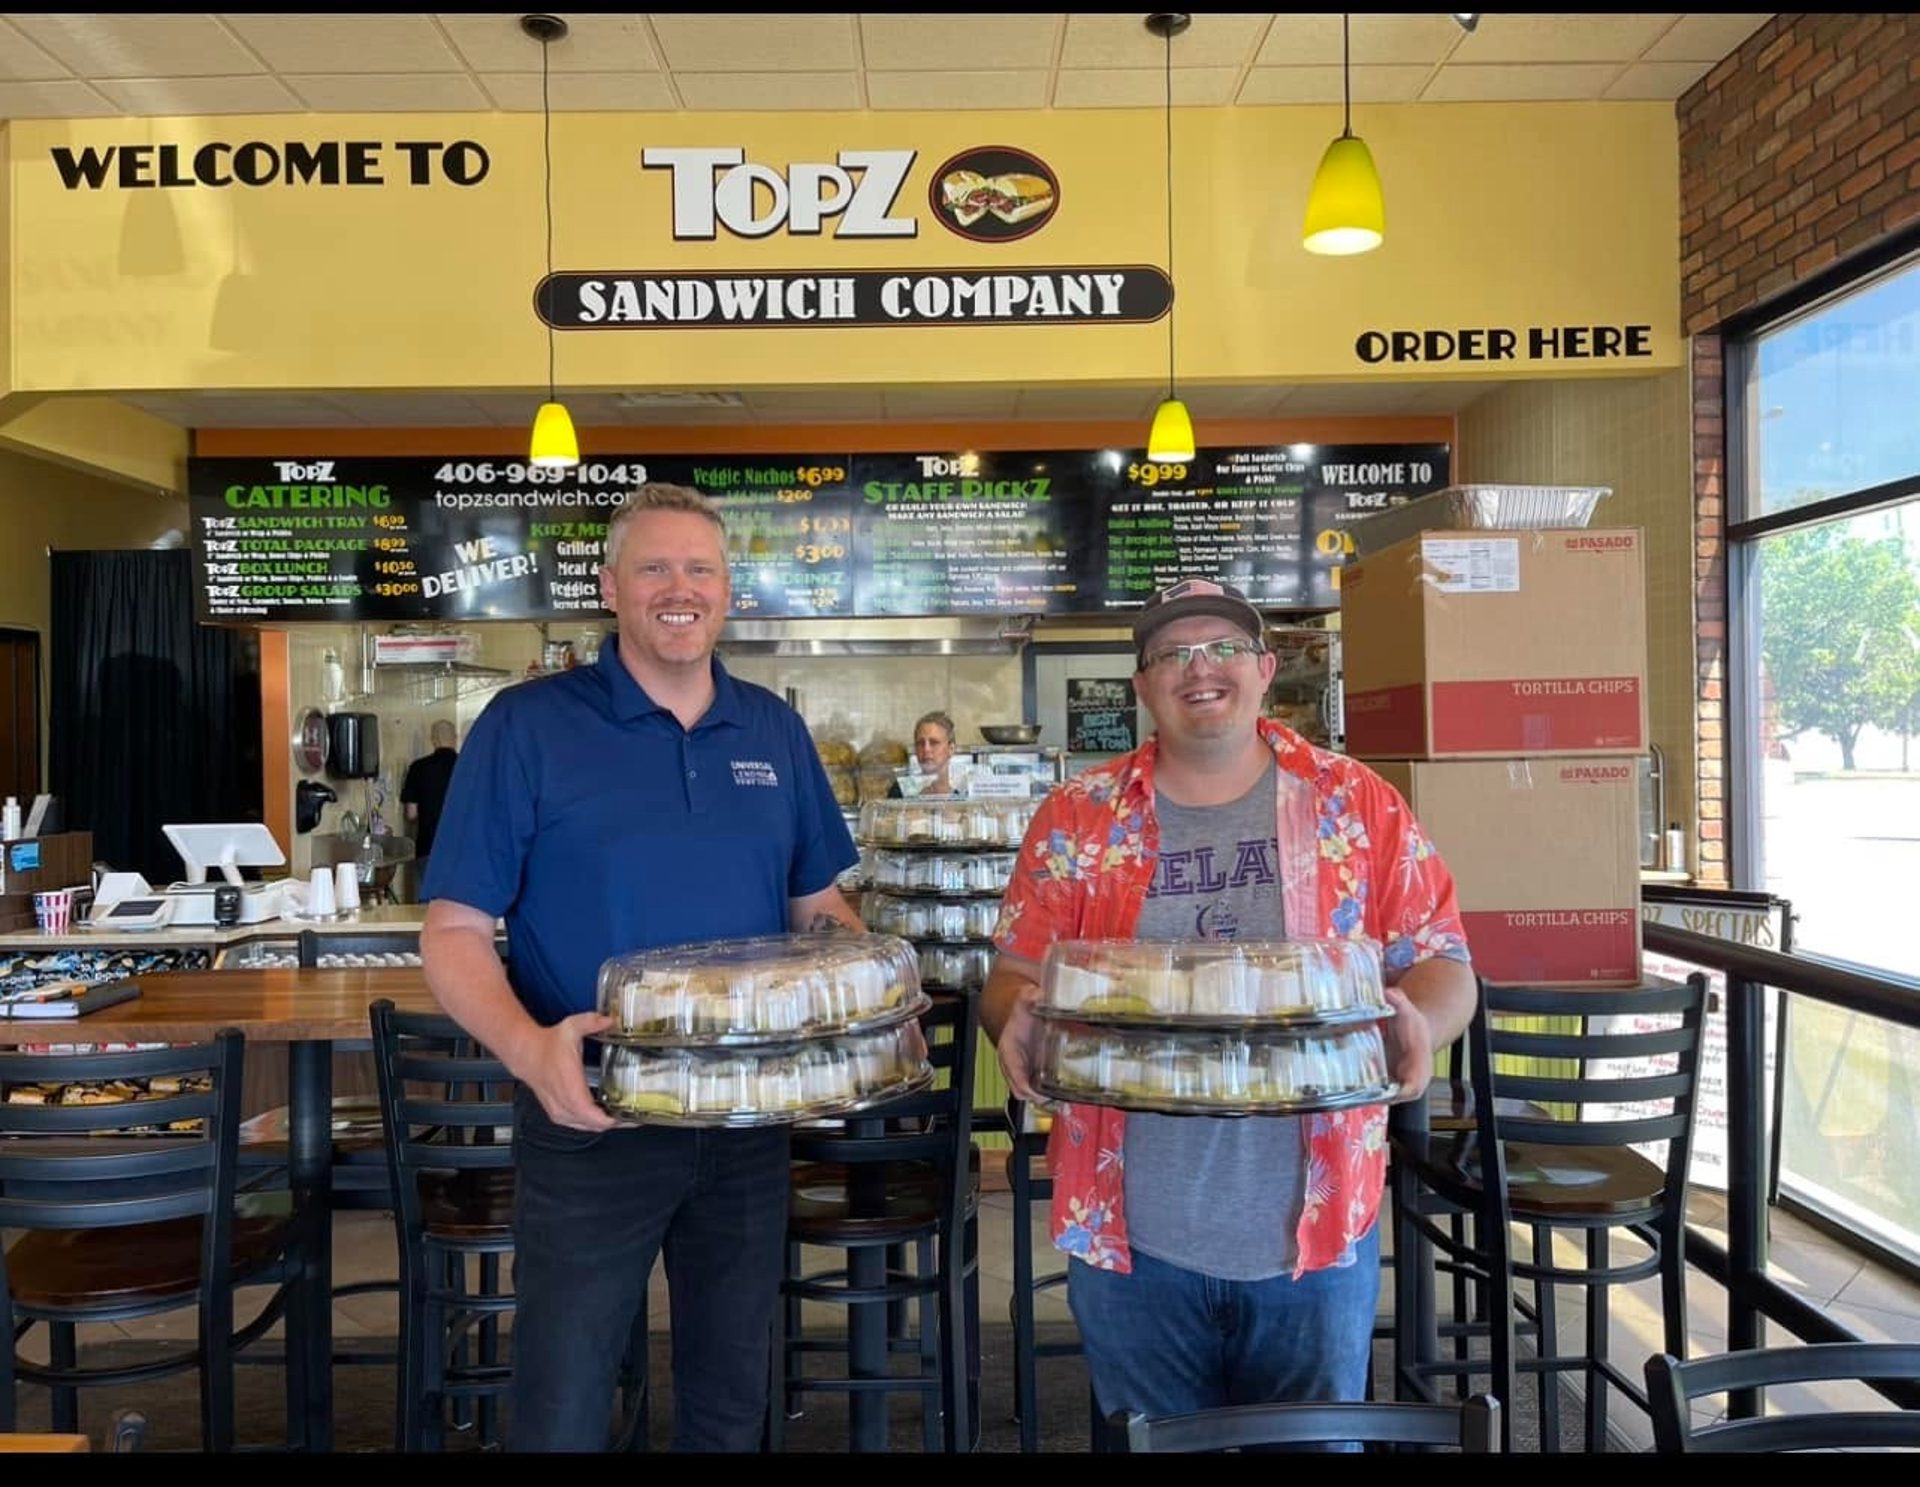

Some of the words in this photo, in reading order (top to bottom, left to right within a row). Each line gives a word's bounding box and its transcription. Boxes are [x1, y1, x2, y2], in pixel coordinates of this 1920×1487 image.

[51, 141, 383, 189] WELCOME
[395, 141, 490, 186] TO
[578, 278, 855, 322] SANDWICH
[881, 274, 1125, 318] COMPANY
[1355, 329, 1516, 363] ORDER
[1529, 325, 1652, 359] HERE
[435, 463, 647, 484] 406-969-1043
[693, 467, 740, 487] Veggie
[1321, 463, 1404, 485] WELCOME
[1410, 463, 1432, 484] TO
[225, 485, 391, 509] CATERING
[864, 481, 954, 504] STAFF
[962, 478, 1052, 501] PICKZ
[238, 517, 323, 528] SANDWICH
[327, 516, 367, 528] TRAY
[578, 523, 608, 537] ME
[239, 540, 291, 550] TOTAL
[293, 539, 369, 550] PACKAGE
[454, 536, 497, 564] WE
[557, 541, 599, 555] Grilled
[1580, 537, 1633, 548] PASADO
[240, 563, 272, 573] BOX
[275, 562, 328, 573] LUNCH
[422, 553, 539, 598] DELIVER!
[241, 585, 297, 596] GROUP
[300, 584, 362, 596] SALADS
[1512, 682, 1585, 695] TORTILLA
[1588, 681, 1633, 694] CHIPS
[1575, 767, 1629, 778] PASADO
[1146, 837, 1279, 899] ELA
[1506, 913, 1581, 927] TORTILLA
[1583, 912, 1629, 925] CHIPS
